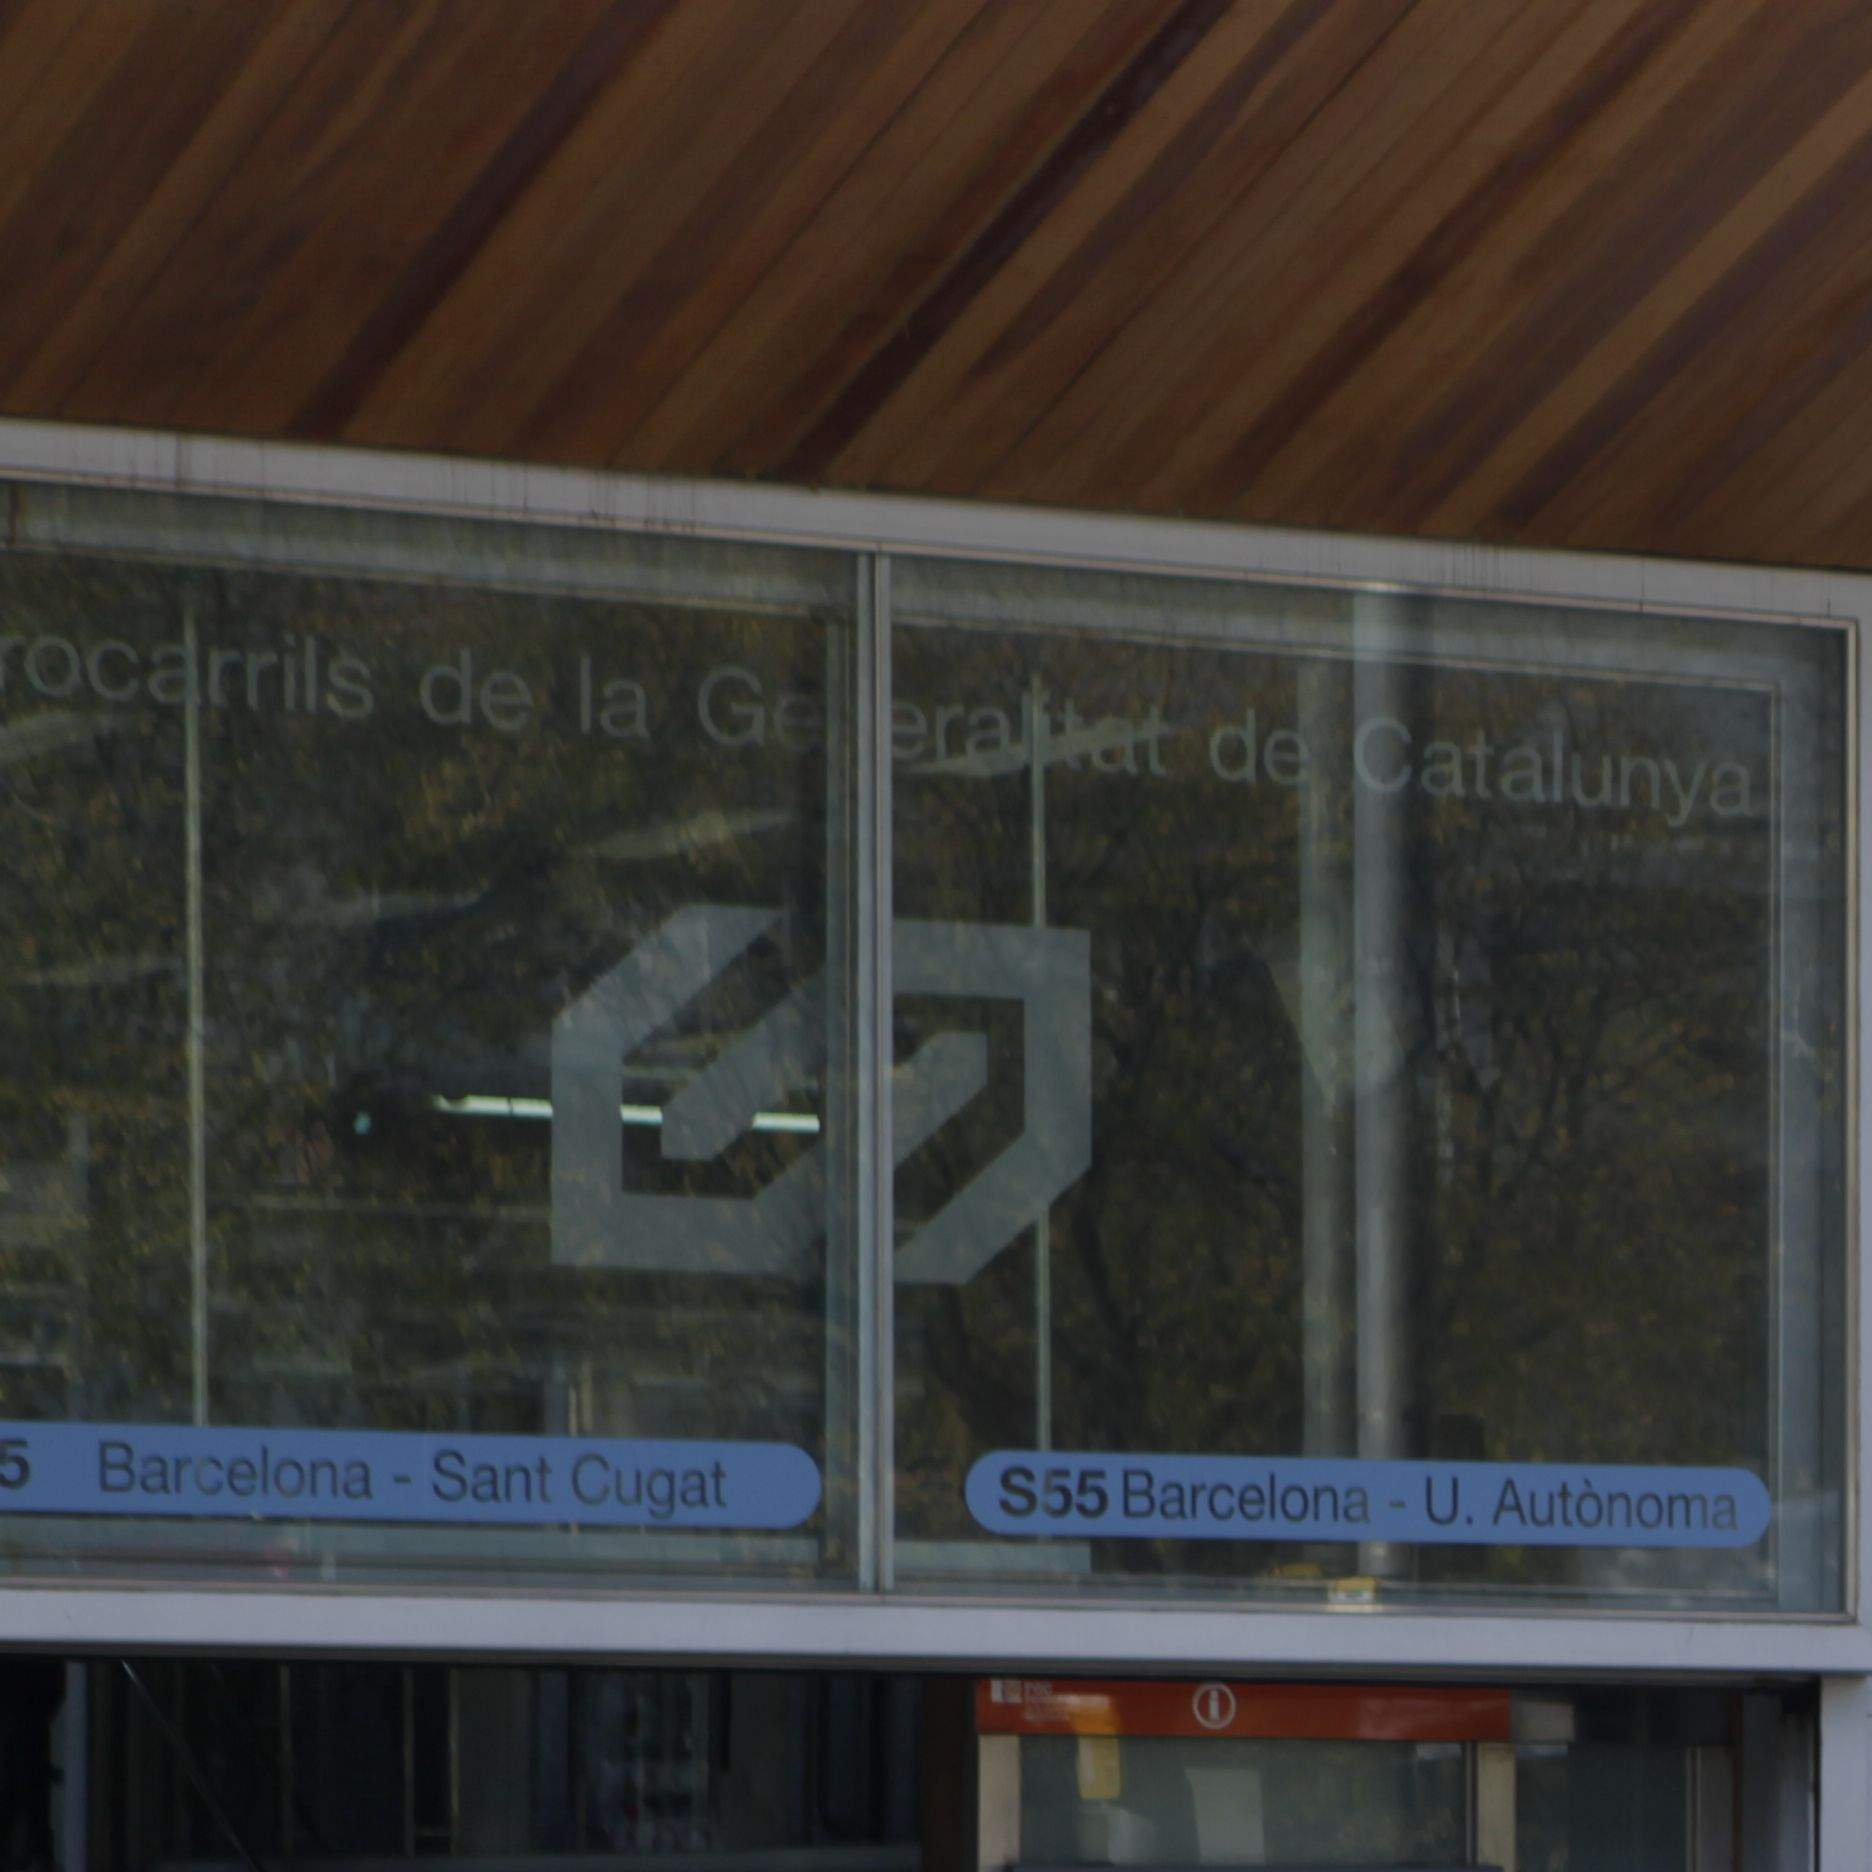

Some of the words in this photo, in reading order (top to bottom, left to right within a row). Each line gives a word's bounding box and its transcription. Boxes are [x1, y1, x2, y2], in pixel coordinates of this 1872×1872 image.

[418, 647, 534, 731] de
[579, 652, 651, 740] la
[699, 664, 1168, 778] Geeralitat
[1208, 708, 1310, 786] de
[1353, 716, 1755, 828] Catalunya
[97, 1438, 373, 1500] Barcelona
[432, 1449, 552, 1507] Sant
[570, 1452, 728, 1521] Cugat
[997, 1465, 1109, 1520] S55
[1122, 1469, 1370, 1526] Barcelona
[1424, 1475, 1474, 1528] U.
[1490, 1477, 1740, 1532] Autònoma
